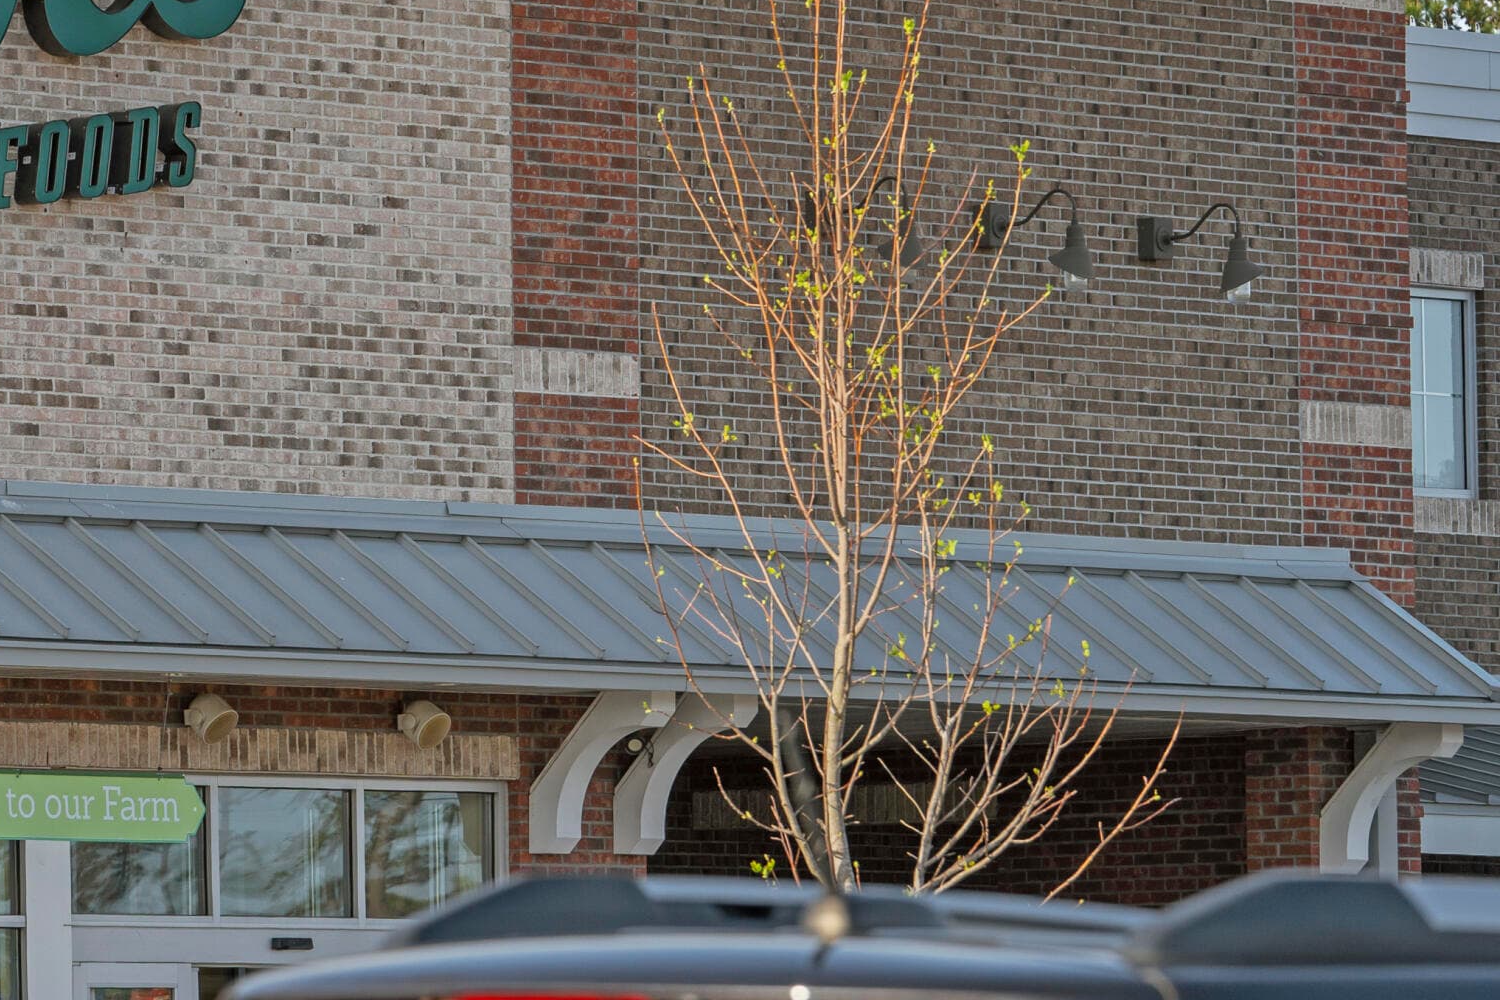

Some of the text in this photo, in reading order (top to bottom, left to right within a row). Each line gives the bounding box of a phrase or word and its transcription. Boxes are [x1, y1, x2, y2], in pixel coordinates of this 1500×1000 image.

[5, 787, 36, 819] to
[44, 798, 95, 821] our
[101, 785, 181, 823] Farm
